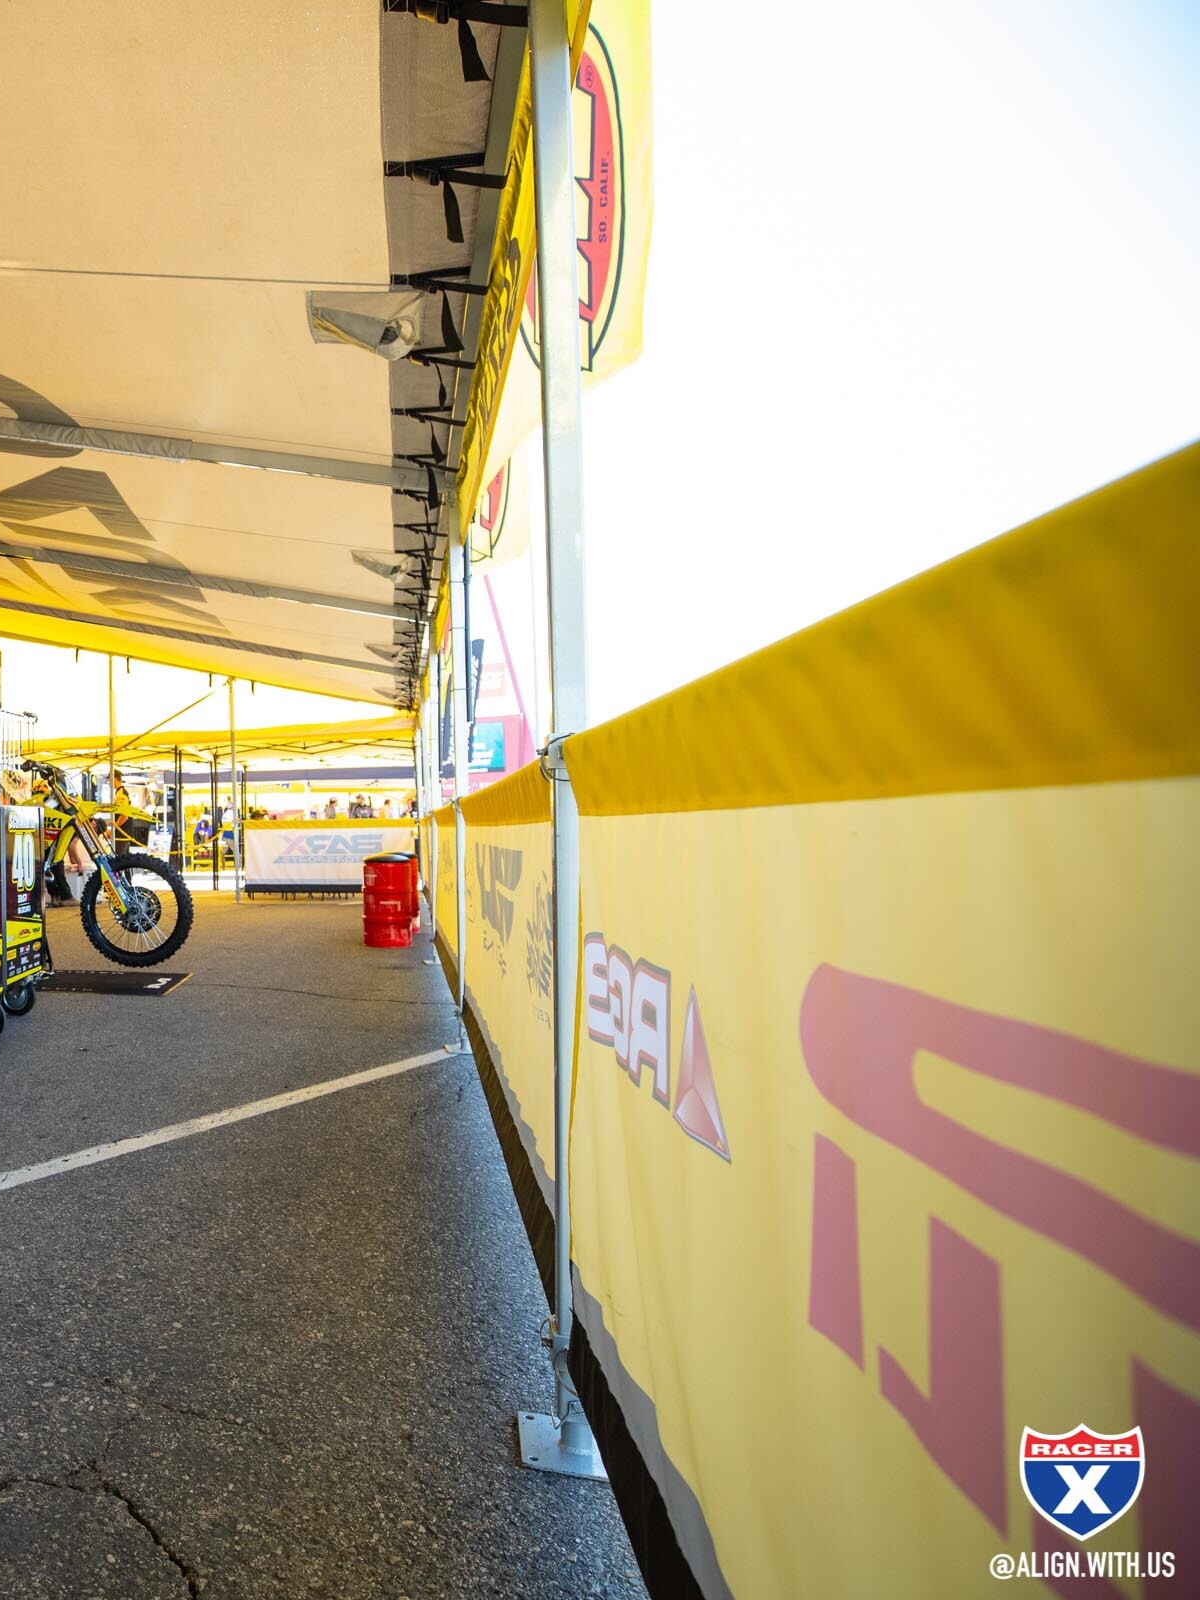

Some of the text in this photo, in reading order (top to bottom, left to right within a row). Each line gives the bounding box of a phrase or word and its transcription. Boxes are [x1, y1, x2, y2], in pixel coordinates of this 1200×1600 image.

[598, 151, 611, 243] SO. CALIF.
[12, 831, 35, 889] 40
